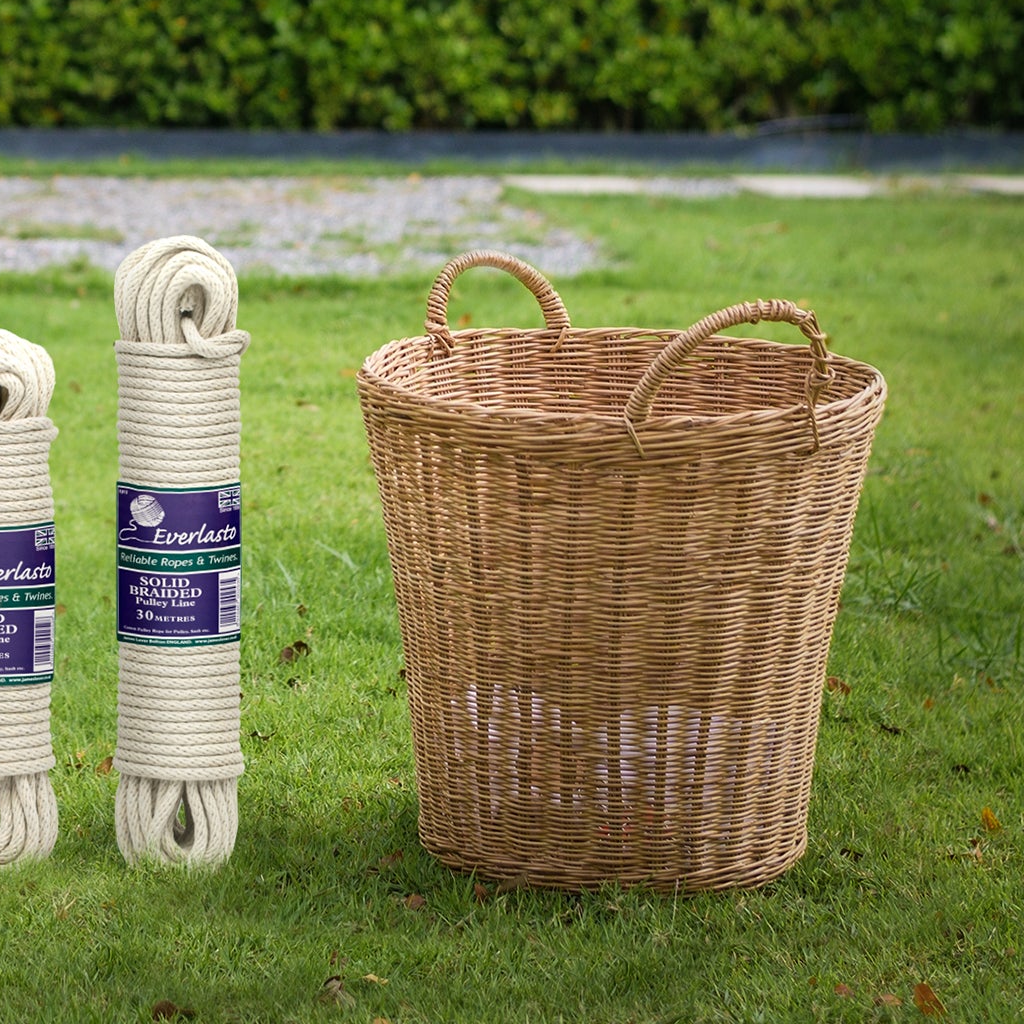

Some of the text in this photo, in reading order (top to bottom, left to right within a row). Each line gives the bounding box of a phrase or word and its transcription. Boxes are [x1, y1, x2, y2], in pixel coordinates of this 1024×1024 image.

[153, 523, 236, 545] Everlasto
[120, 552, 157, 565] Reliable
[161, 557, 192, 568] Ropes
[196, 556, 204, 565] &
[140, 576, 190, 587] SOLID
[12, 593, 20, 601] &
[130, 585, 202, 598] BRAIDED
[136, 597, 196, 608] Pulley Line
[136, 609, 153, 621] 30
